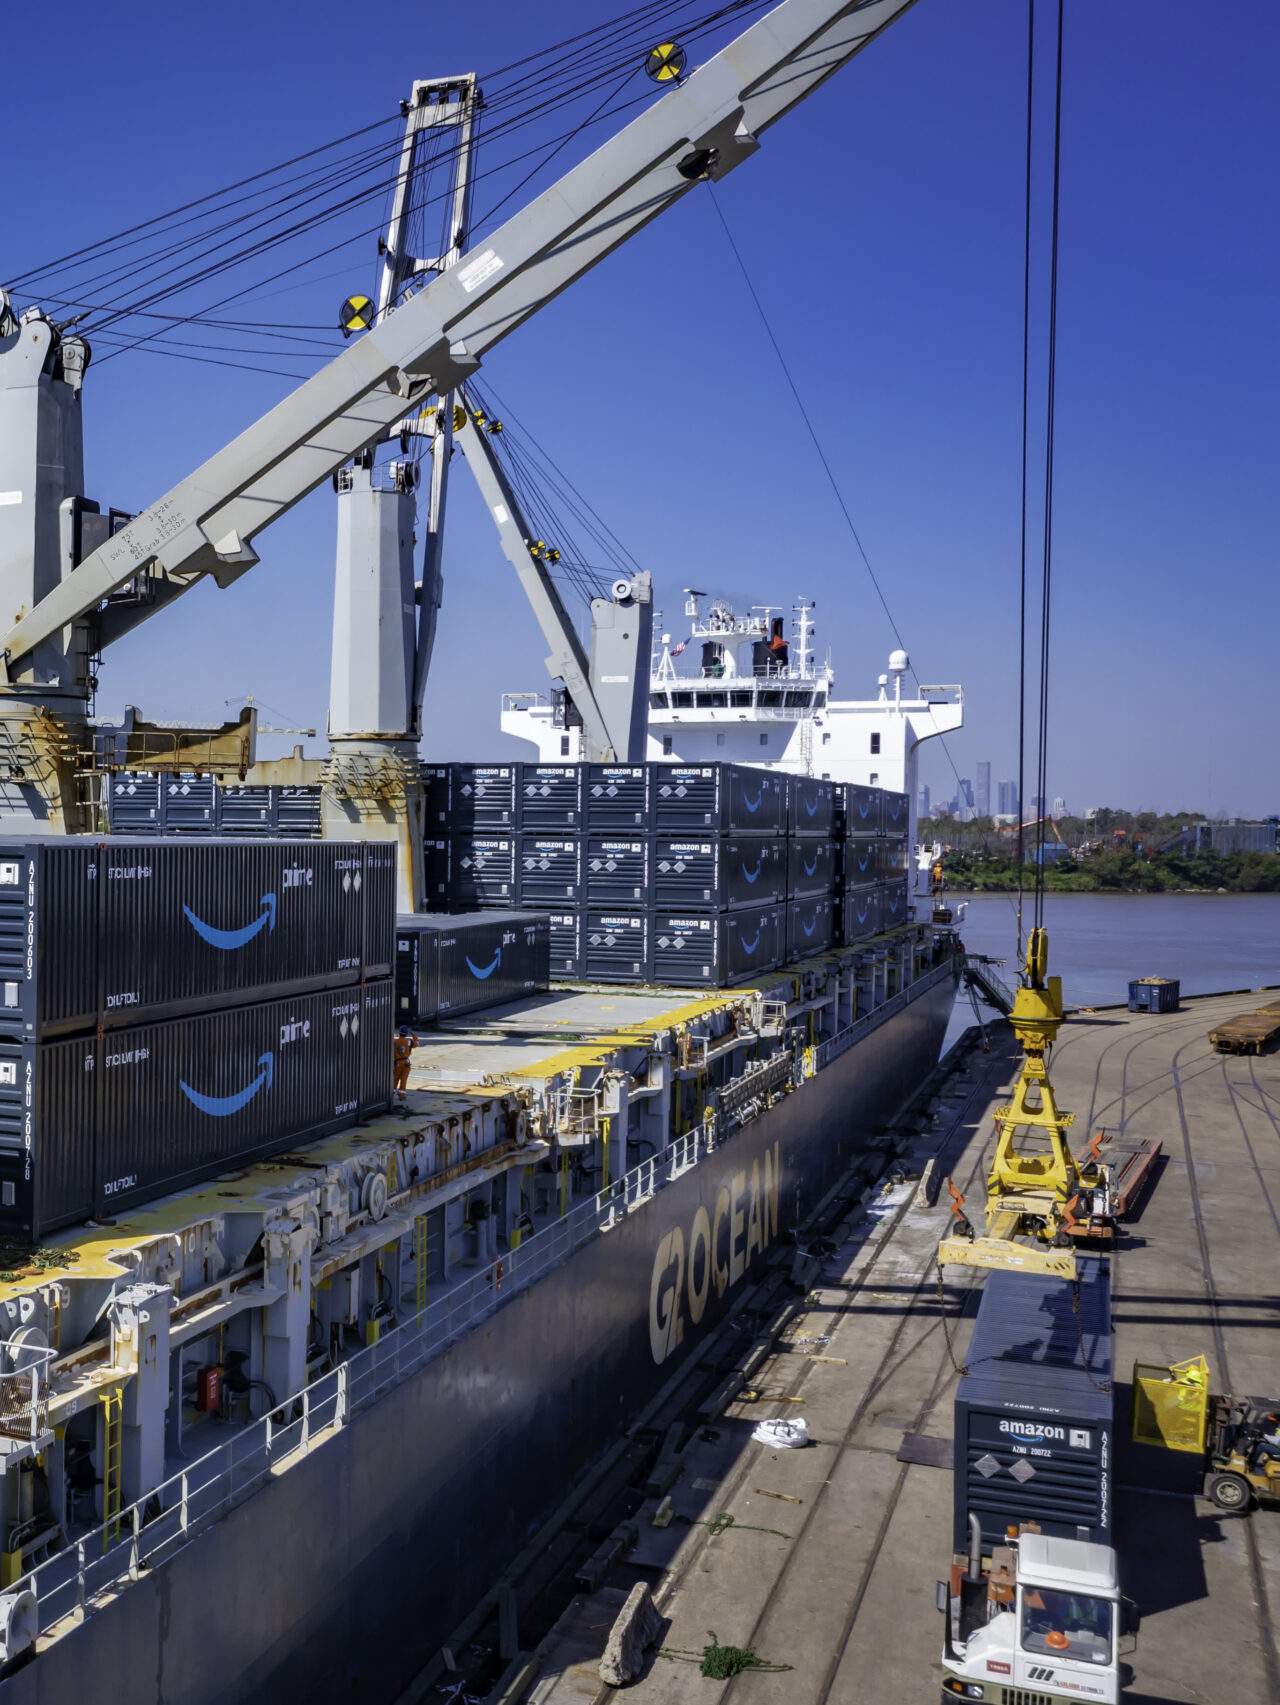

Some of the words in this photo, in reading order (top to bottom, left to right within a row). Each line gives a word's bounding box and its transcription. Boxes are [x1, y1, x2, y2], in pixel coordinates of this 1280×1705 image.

[671, 768, 701, 776] amazon
[535, 841, 564, 849] amazon
[601, 842, 630, 850] amazon
[669, 843, 700, 851] amazon
[600, 917, 629, 925] amazon
[668, 919, 698, 927] amazon
[26, 911, 35, 980] 200603
[24, 1061, 33, 1107] AZNU
[23, 1112, 33, 1181] 200728
[998, 1420, 1065, 1440] amazon
[1012, 1445, 1026, 1454] AZNU
[1030, 1447, 1051, 1457] 200722
